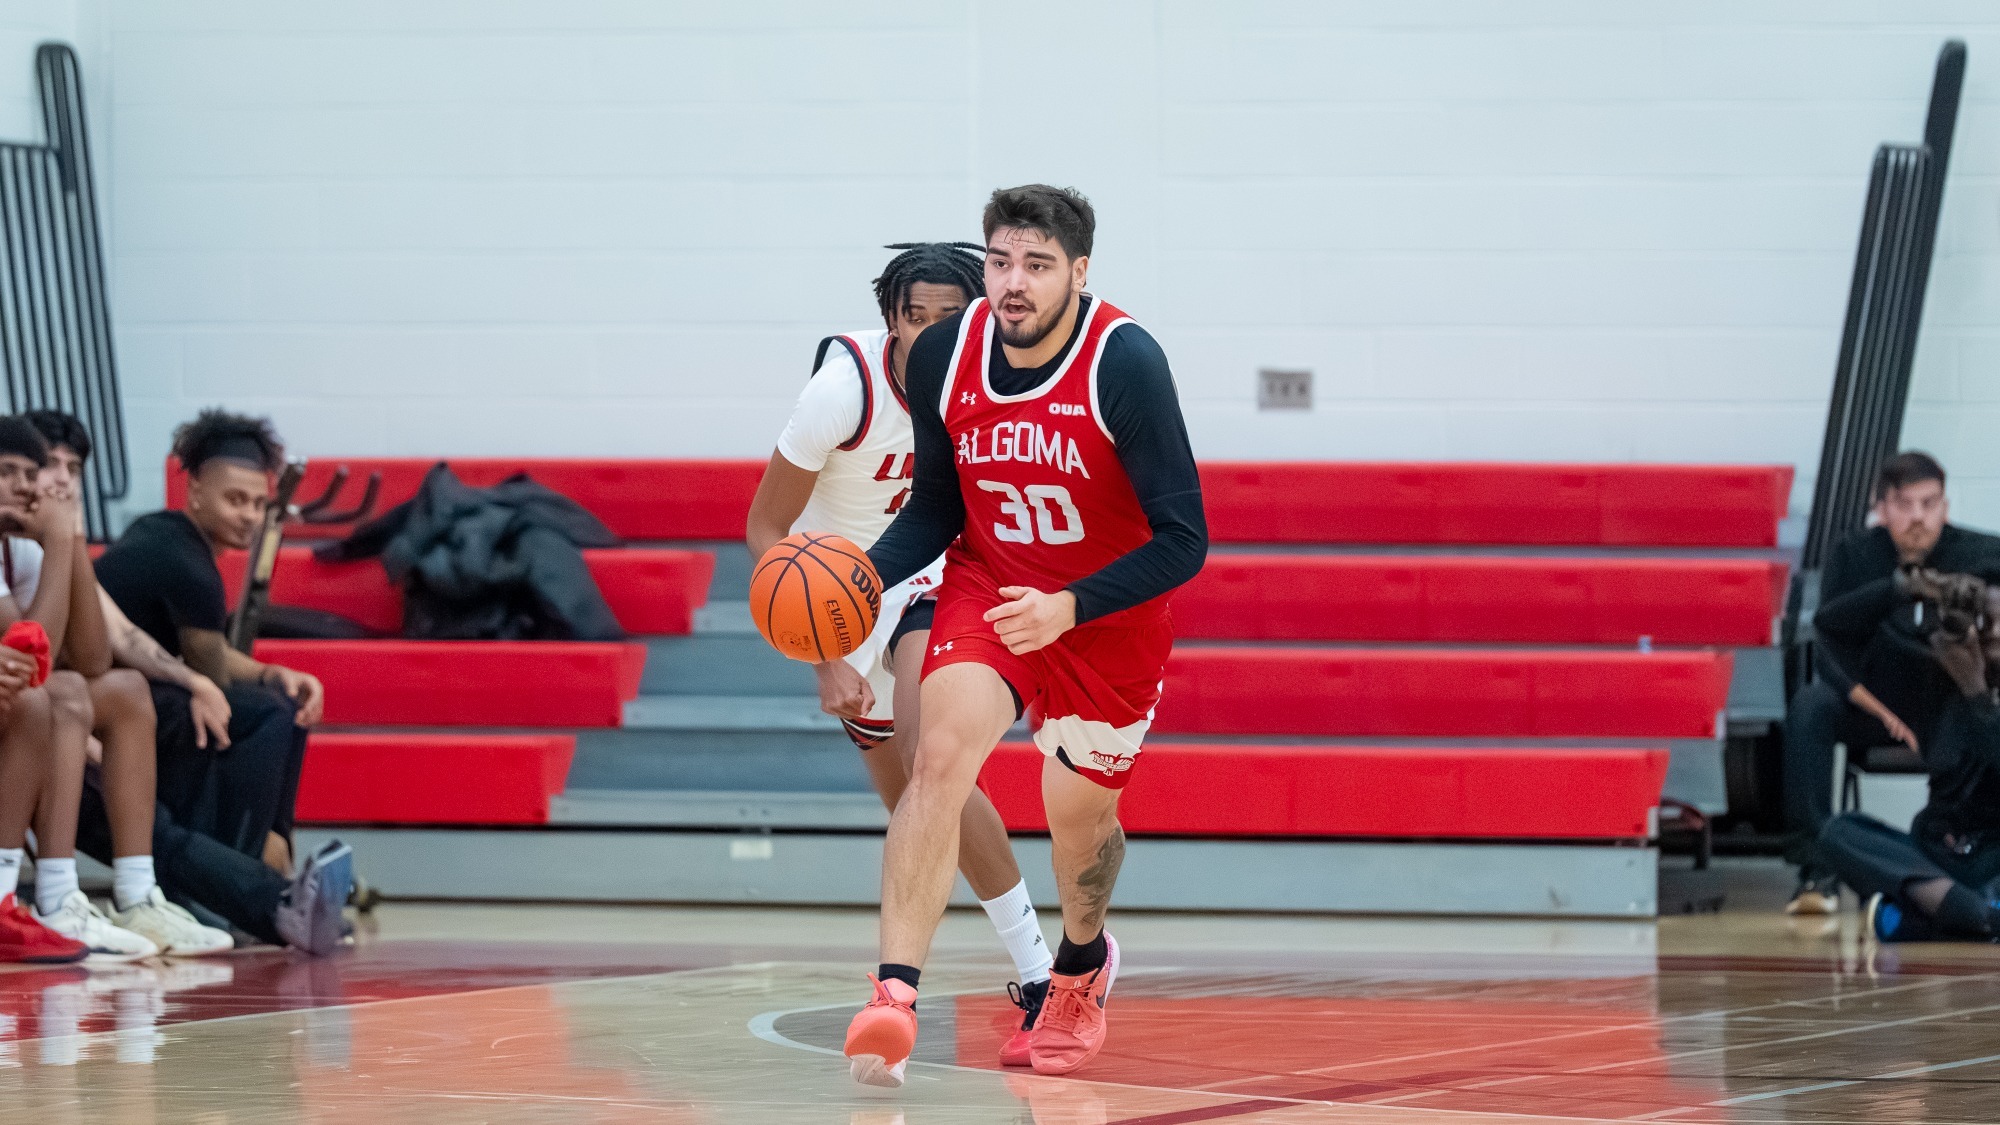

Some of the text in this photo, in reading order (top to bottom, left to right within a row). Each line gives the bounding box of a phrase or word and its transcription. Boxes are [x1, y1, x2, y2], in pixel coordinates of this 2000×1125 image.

[1048, 402, 1087, 416] OUA
[958, 421, 1091, 480] ALGOMA
[976, 479, 1085, 545] 30
